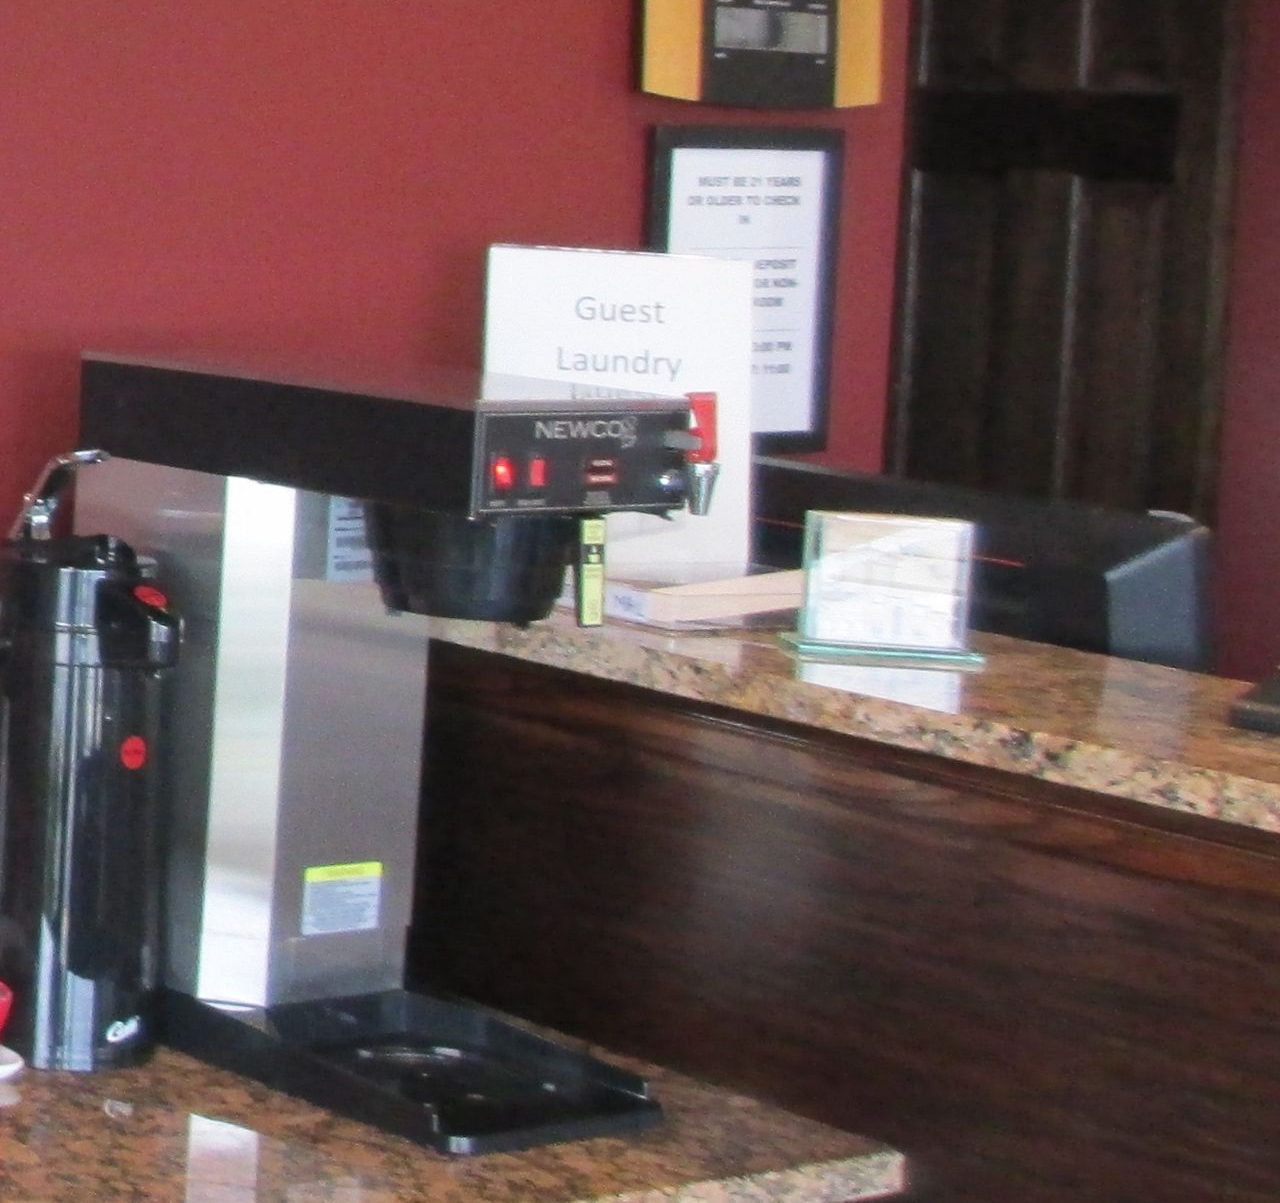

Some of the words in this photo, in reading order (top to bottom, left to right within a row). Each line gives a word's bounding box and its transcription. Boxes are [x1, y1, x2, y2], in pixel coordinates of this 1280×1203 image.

[698, 176, 729, 187] MUST
[733, 176, 747, 187] BE
[750, 176, 761, 187] 21
[764, 176, 800, 187] YEARS
[687, 195, 703, 206] OR
[706, 195, 742, 206] OLDER
[745, 195, 761, 206] TO
[764, 195, 800, 206] CHECK
[575, 296, 666, 324] Guest
[556, 346, 682, 382] Laundry
[534, 420, 623, 439] NEWCO
